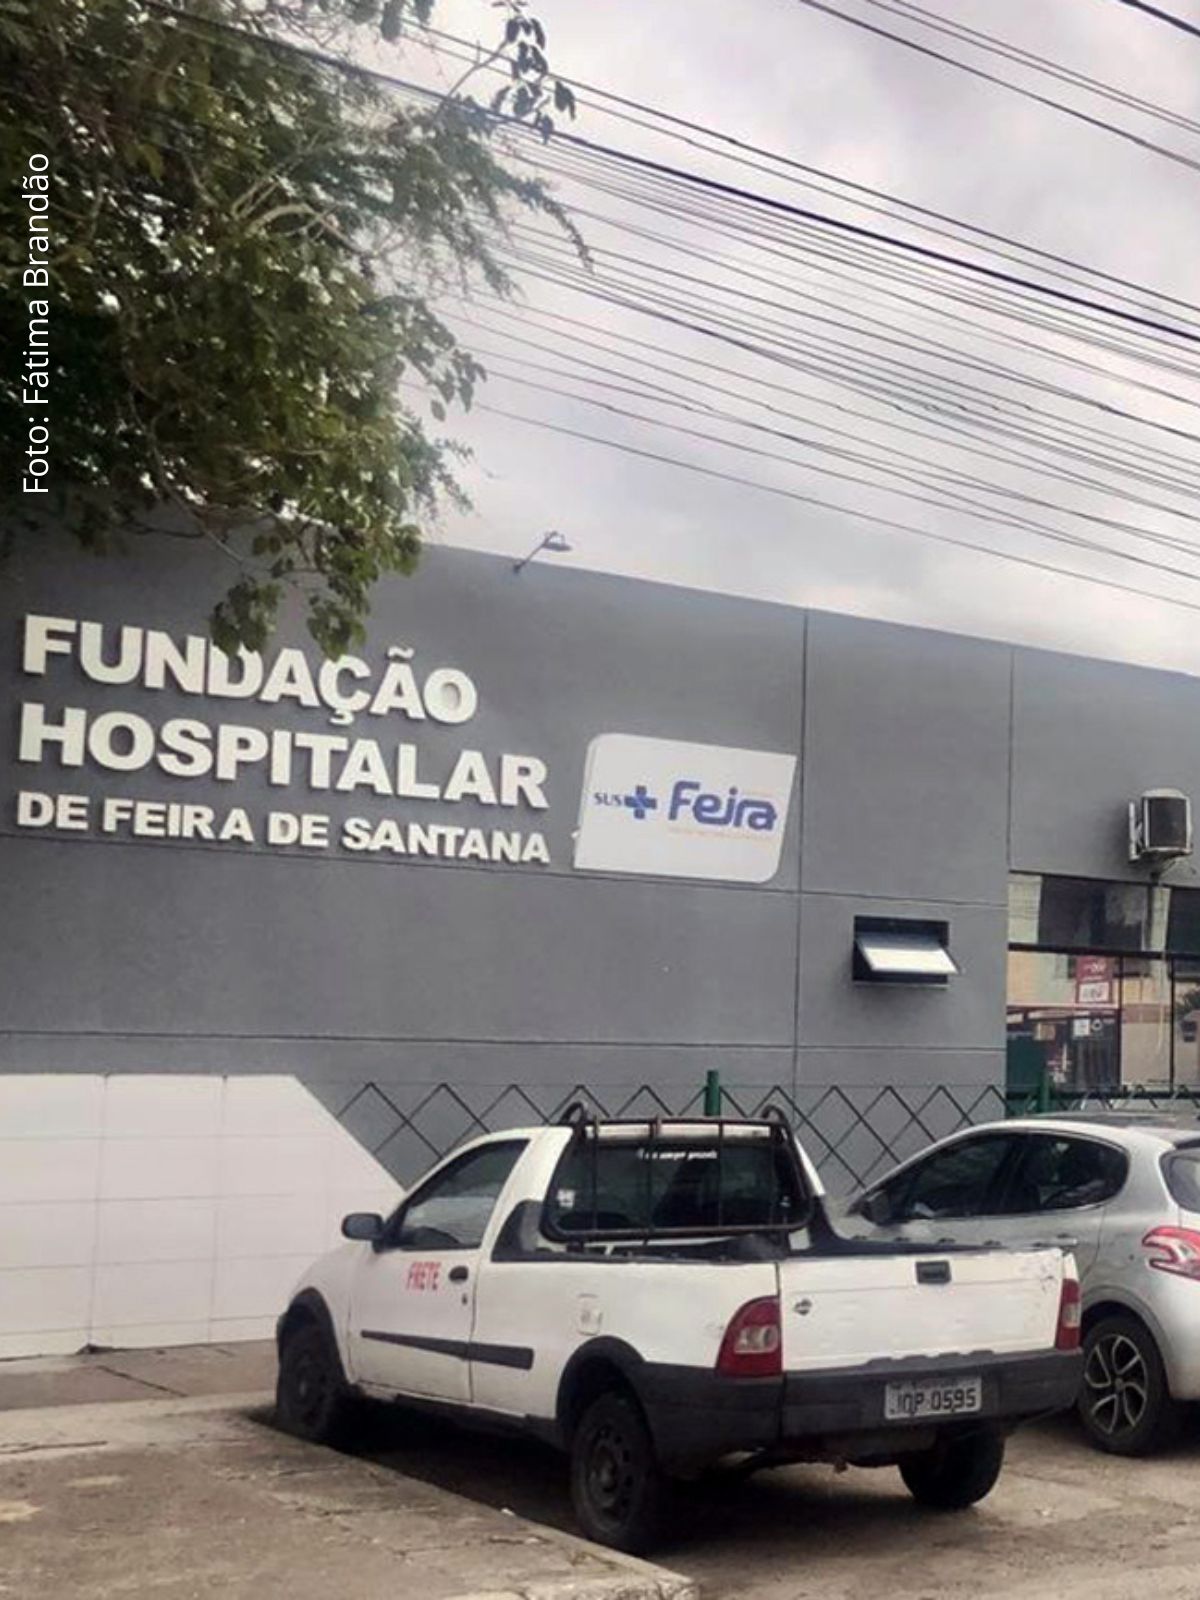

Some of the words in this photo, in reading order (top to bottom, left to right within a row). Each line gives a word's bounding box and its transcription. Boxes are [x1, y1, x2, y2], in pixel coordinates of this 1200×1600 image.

[23, 614, 478, 725] FUNDAÇÃO
[19, 702, 550, 809] HOSPITALAR
[17, 791, 89, 831] DE
[103, 798, 255, 843] FEIRA
[267, 811, 331, 848] DE
[341, 817, 551, 864] SANTANA
[668, 780, 778, 831] Feira
[930, 1387, 977, 1411] 0595
